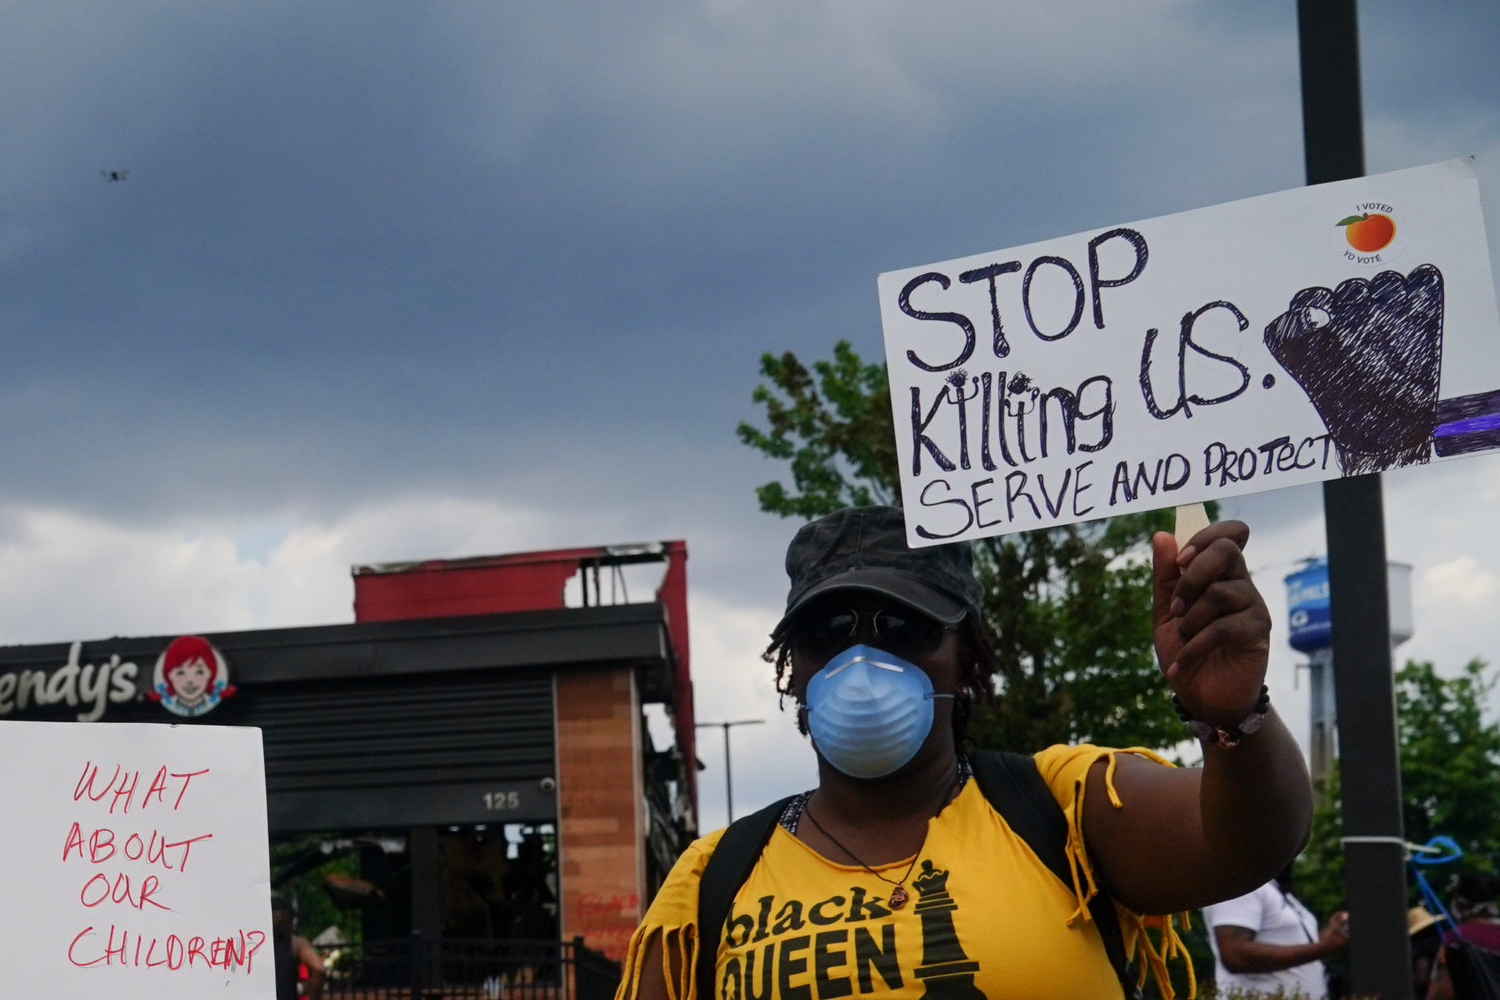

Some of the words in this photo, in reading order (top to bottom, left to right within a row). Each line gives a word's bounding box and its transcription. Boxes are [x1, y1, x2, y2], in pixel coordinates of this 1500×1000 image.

[1361, 202, 1393, 214] VOTED
[1343, 250, 1356, 261] YO
[898, 227, 1149, 373] STOP
[909, 370, 1114, 478] Killing
[1140, 300, 1276, 420] US.
[915, 460, 1096, 540] SERVE
[1109, 453, 1192, 507] AND
[73, 760, 210, 813] WHAT
[484, 791, 519, 810] 125
[63, 821, 213, 872] ABOUT
[80, 872, 171, 910] OUR
[723, 886, 892, 950] black
[67, 923, 266, 973] CHILDREN?
